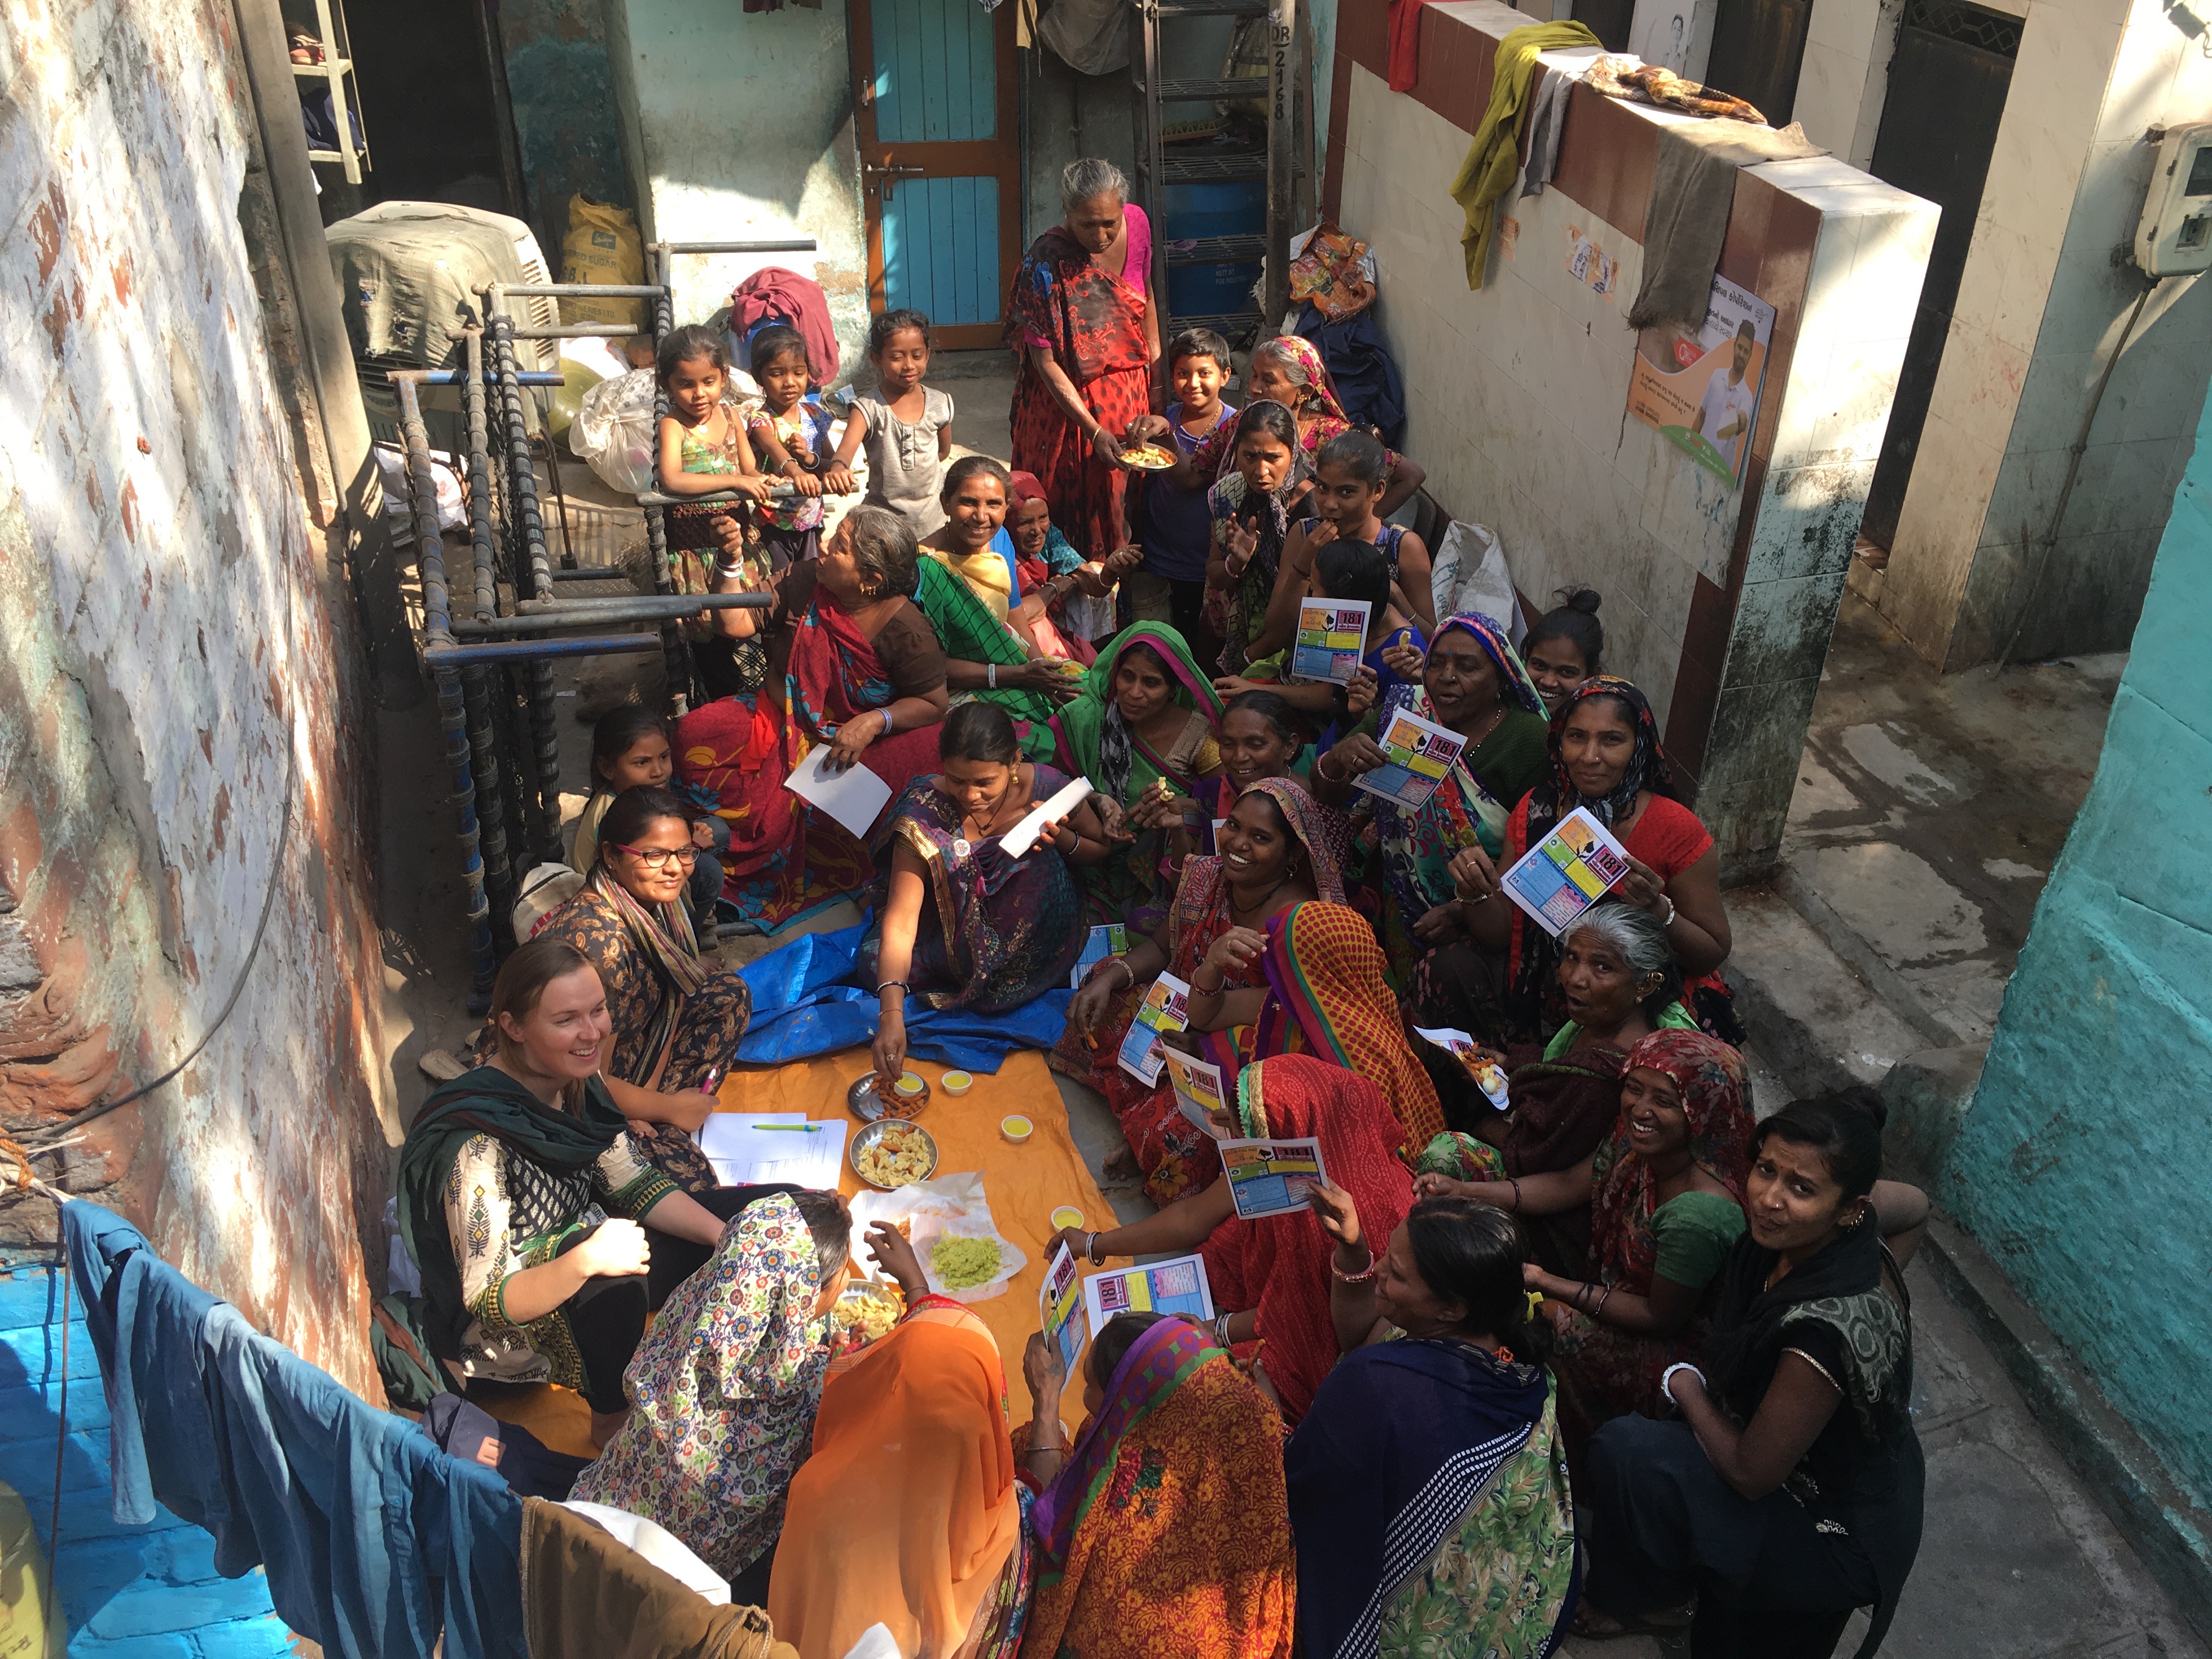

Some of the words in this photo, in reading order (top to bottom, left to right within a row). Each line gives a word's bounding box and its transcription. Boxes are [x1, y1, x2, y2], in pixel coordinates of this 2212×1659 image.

[1272, 26, 1290, 42] DR
[589, 255, 617, 269] SUGAR
[1343, 612, 1362, 624] 181
[1435, 738, 1458, 757] 181
[1599, 852, 1623, 875] 181
[1175, 995, 1187, 1013] 18
[1197, 1071, 1215, 1089] 181
[1058, 1256, 1073, 1283] 181
[1100, 1280, 1117, 1305] 181
